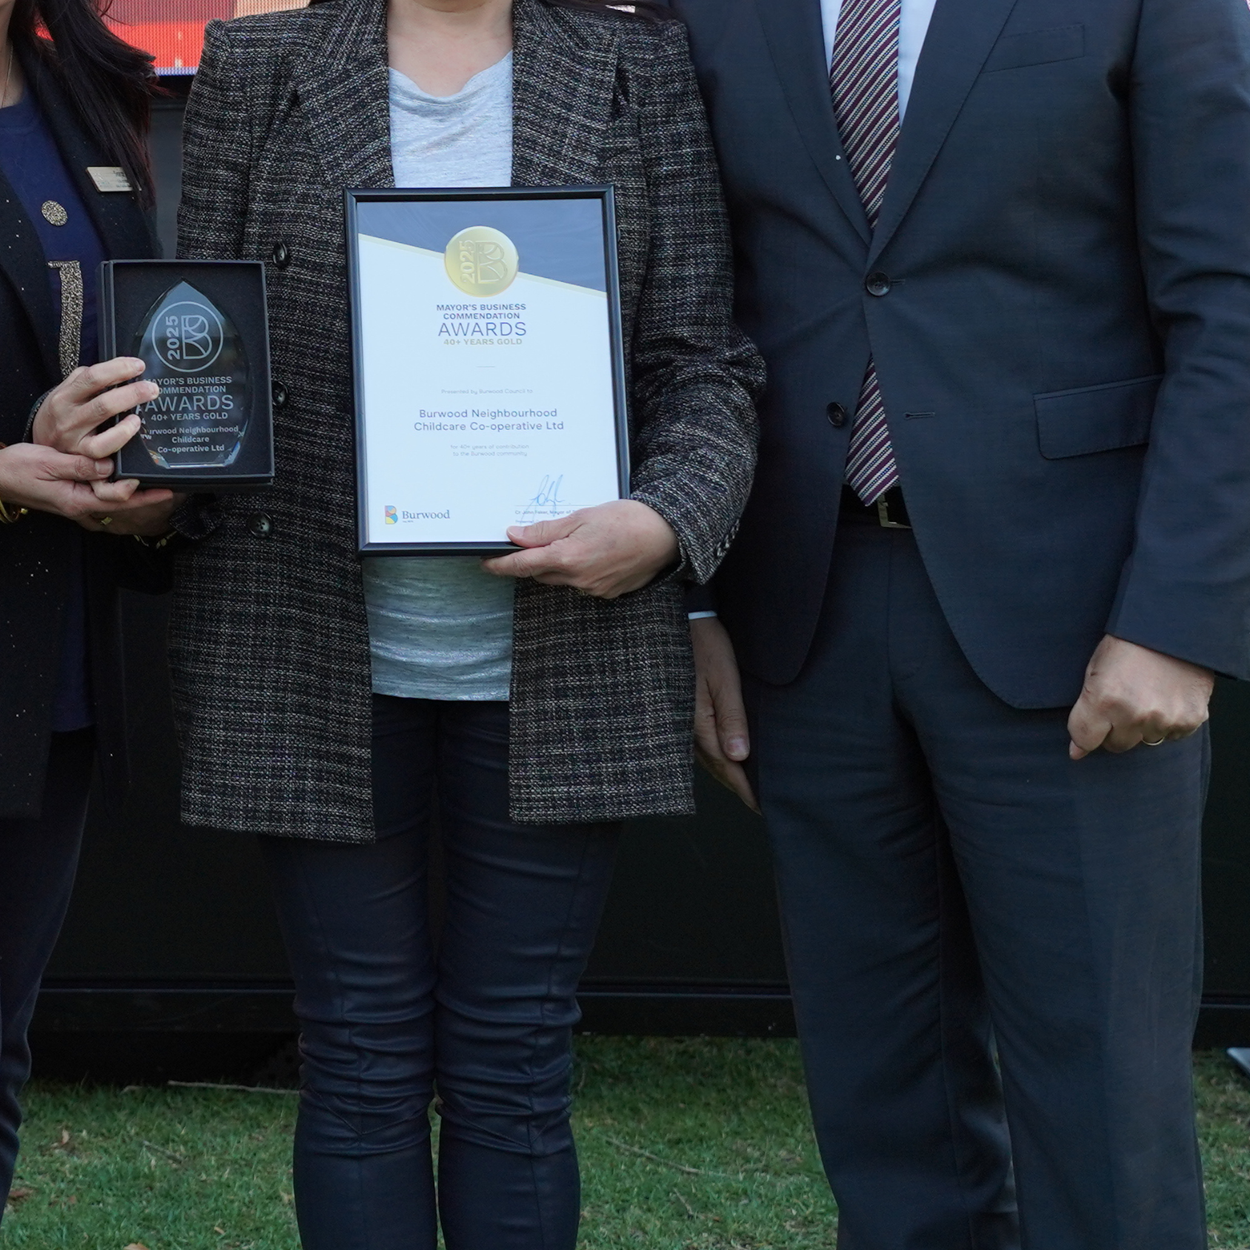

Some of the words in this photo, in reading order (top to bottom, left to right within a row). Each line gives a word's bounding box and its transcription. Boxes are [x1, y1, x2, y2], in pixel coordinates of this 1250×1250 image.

[458, 239, 475, 284] 2025
[480, 303, 526, 311] BUSINESS
[443, 312, 520, 320] COMMENDATION
[438, 321, 527, 337] AWARDS
[165, 315, 181, 360] 2025
[443, 338, 461, 346] 40+
[187, 376, 232, 384] BUSINESS
[158, 385, 226, 394] OMMENDATION
[144, 395, 234, 412] AWARDS
[170, 413, 200, 421] YEARS
[203, 412, 228, 420] GOLD
[419, 409, 468, 418] Burwood
[471, 408, 557, 420] Neighbourhood
[179, 425, 239, 435] Neighbourhood
[414, 422, 466, 431] Childcare
[470, 421, 542, 432] Co-operative
[546, 421, 564, 430] Ltd
[157, 445, 209, 454] Co-operative
[211, 444, 225, 452] Ltd
[402, 509, 450, 519] Burwood
